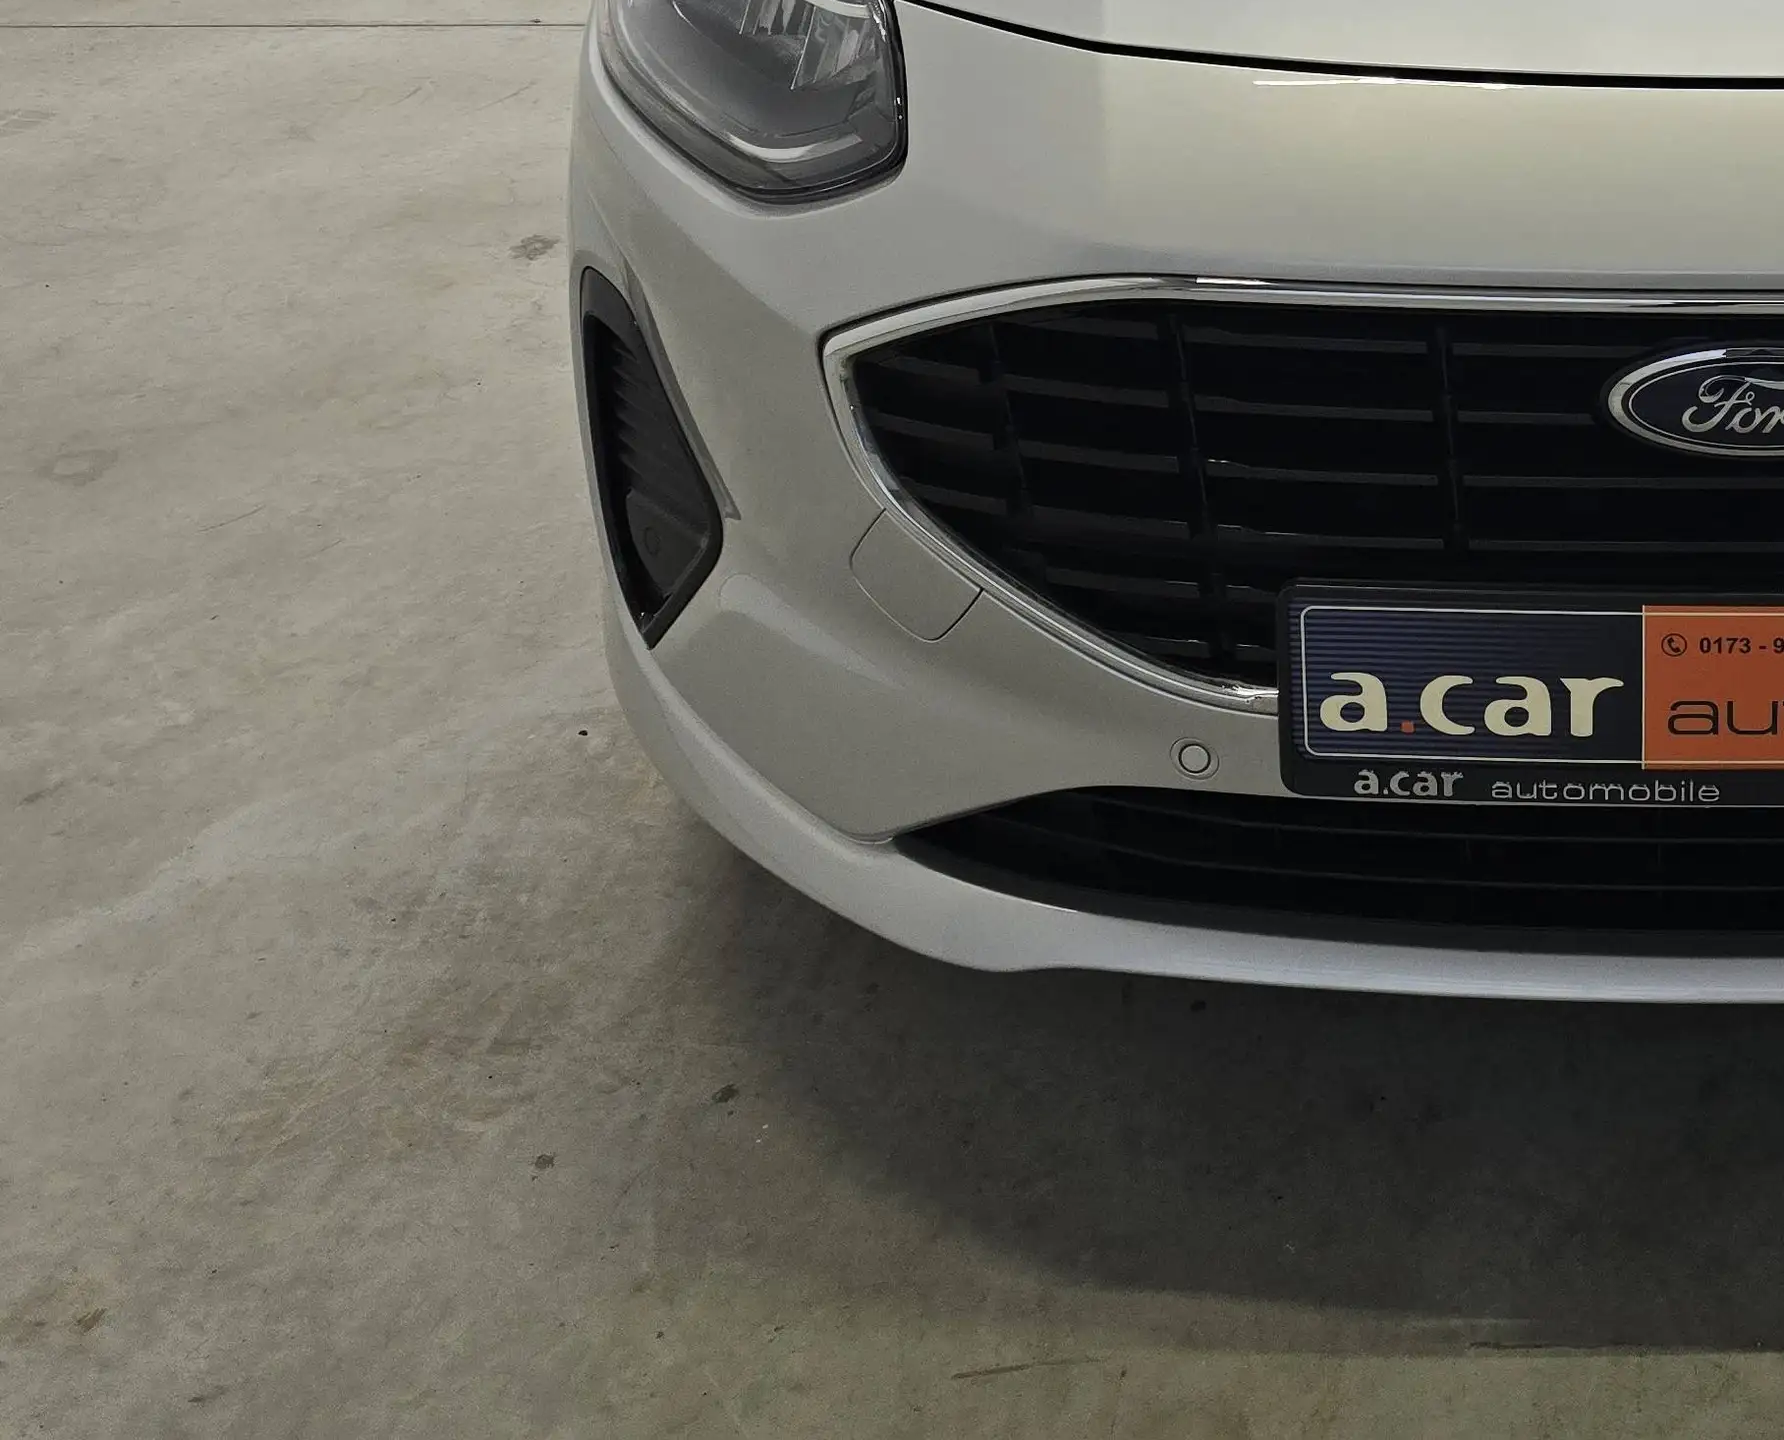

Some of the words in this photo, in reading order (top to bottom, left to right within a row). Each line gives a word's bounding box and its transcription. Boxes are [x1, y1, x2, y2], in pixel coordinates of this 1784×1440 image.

[1699, 636, 1752, 655] 0173
[1319, 671, 1625, 738] a.car
[1352, 768, 1465, 798] a.car
[1491, 779, 1721, 803] automobile
